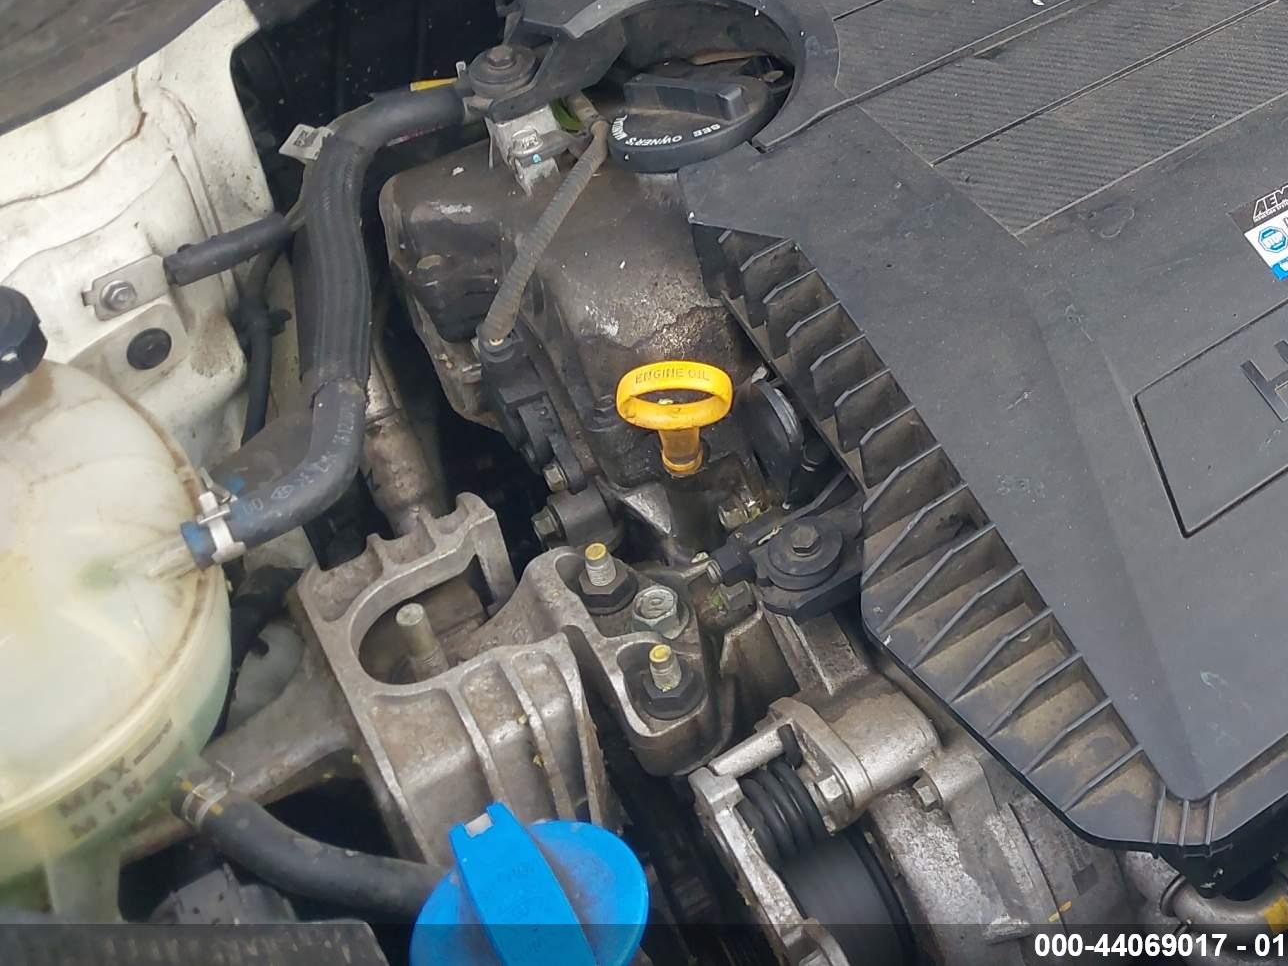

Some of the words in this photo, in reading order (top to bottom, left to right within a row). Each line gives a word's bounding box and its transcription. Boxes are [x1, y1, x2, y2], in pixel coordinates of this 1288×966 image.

[635, 368, 684, 384] ENGINE
[688, 368, 710, 382] OIL
[57, 757, 131, 818] MAX
[70, 779, 144, 840] MIN
